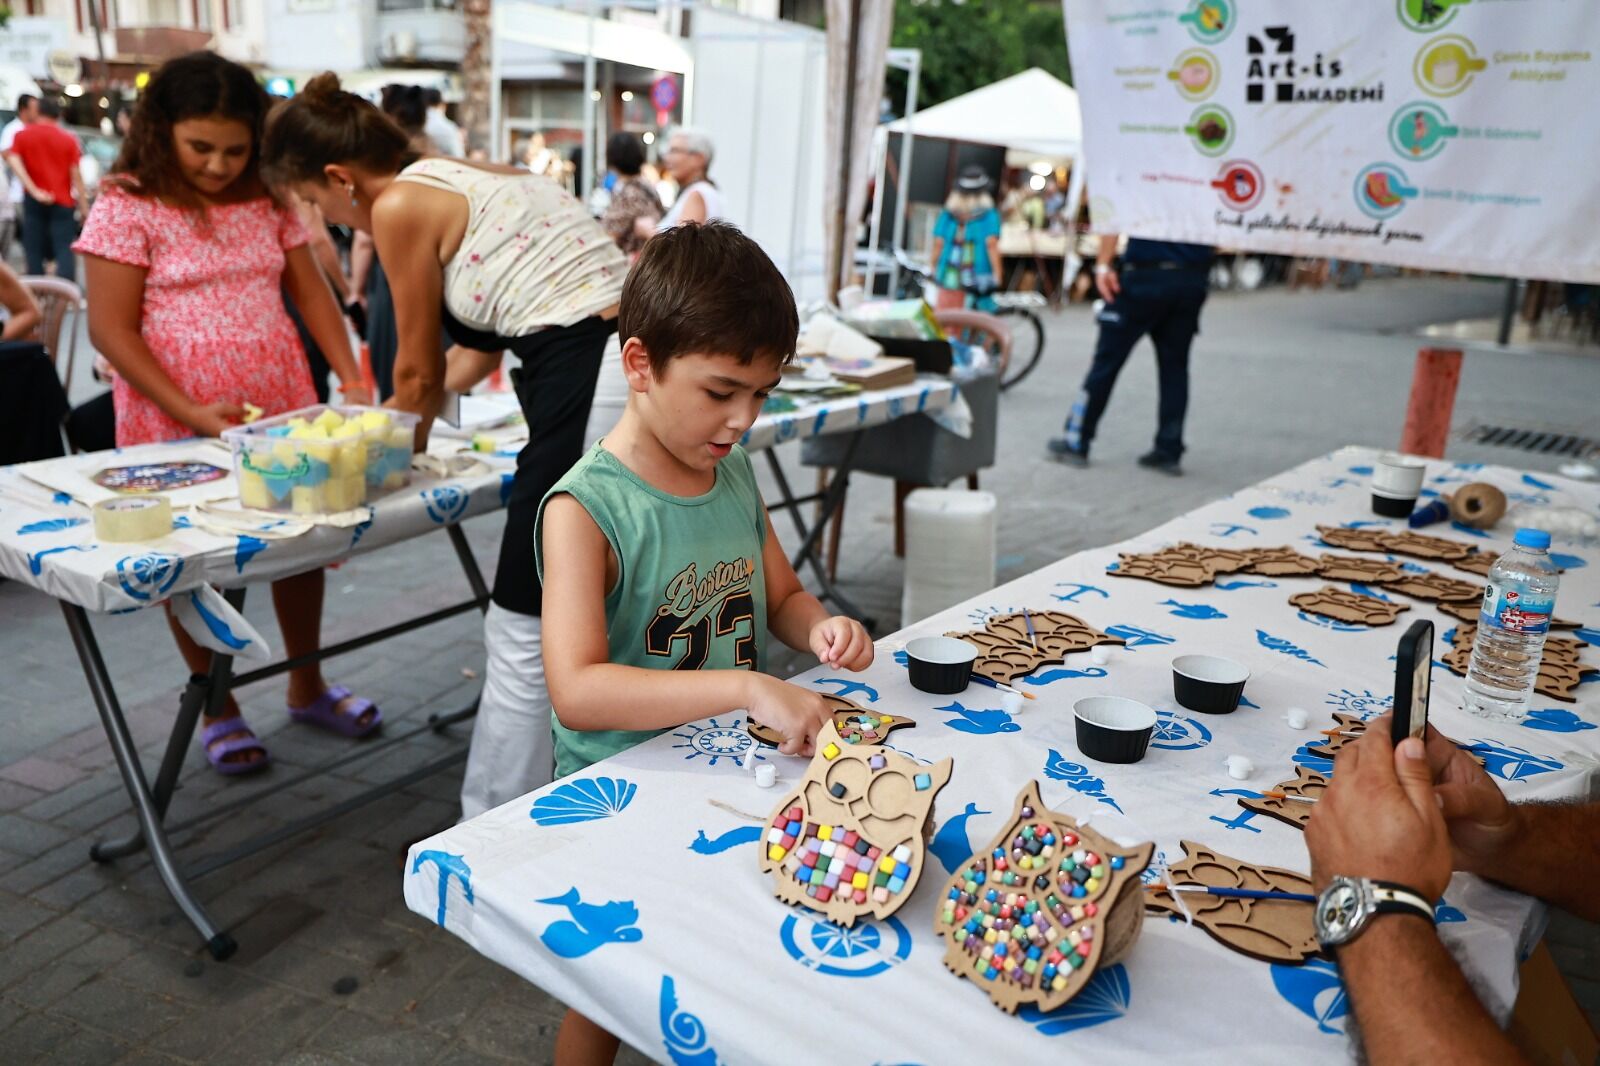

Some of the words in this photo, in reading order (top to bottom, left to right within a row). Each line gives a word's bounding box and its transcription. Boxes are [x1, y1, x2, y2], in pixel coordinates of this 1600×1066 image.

[1248, 53, 1341, 78] Art-is
[1295, 83, 1384, 101] AKADEMİ
[658, 557, 751, 618] Boston
[646, 590, 757, 671] 23
